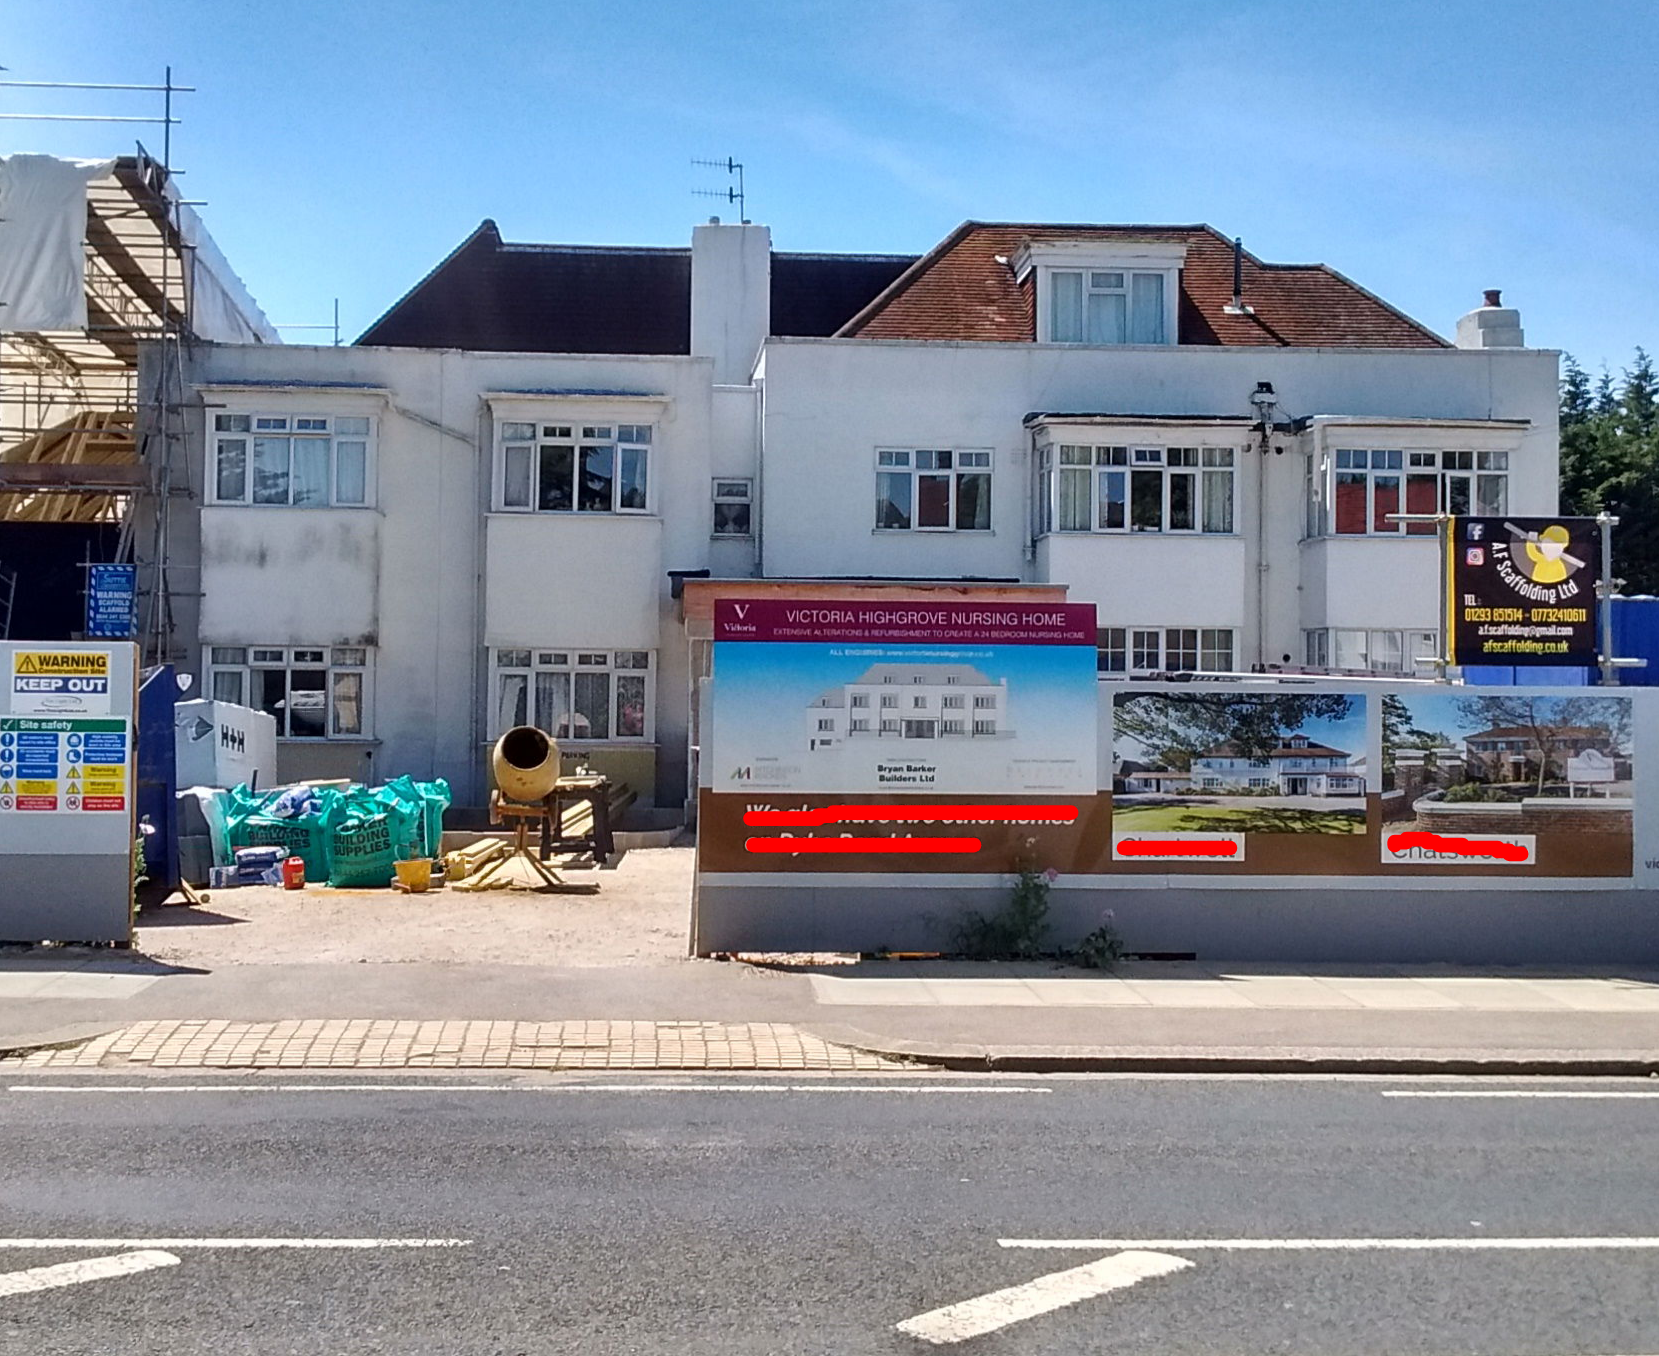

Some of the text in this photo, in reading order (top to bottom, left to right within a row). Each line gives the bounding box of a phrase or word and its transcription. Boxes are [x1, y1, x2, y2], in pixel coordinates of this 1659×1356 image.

[1491, 542, 1579, 604] A.F Scaffolding Ltd
[786, 609, 1066, 626] VICTORIA HIGHGROVE NURSING HOME
[1464, 608, 1492, 621] 01293
[1531, 608, 1587, 622] 07732410611
[724, 623, 756, 632] Victoria
[773, 628, 811, 636] EXTENSIVE
[814, 628, 862, 636] ALTERATIONS
[871, 629, 931, 638] REFURBISHMENT
[932, 629, 943, 638] TO
[944, 630, 973, 638] CREATE
[991, 631, 1028, 639] BEDROOM
[1029, 631, 1062, 639] NURSING
[1063, 632, 1085, 640] HOME
[1482, 640, 1569, 654] afscaffolding.co.uk
[38, 655, 106, 667] WARNING
[16, 678, 105, 691] KEEP OUT
[19, 720, 72, 731] Site safety
[877, 765, 936, 774] Bryan Barker
[879, 775, 935, 783] Builders Ltd
[334, 828, 389, 845] BUILDING
[334, 839, 391, 856] SUPPLIES
